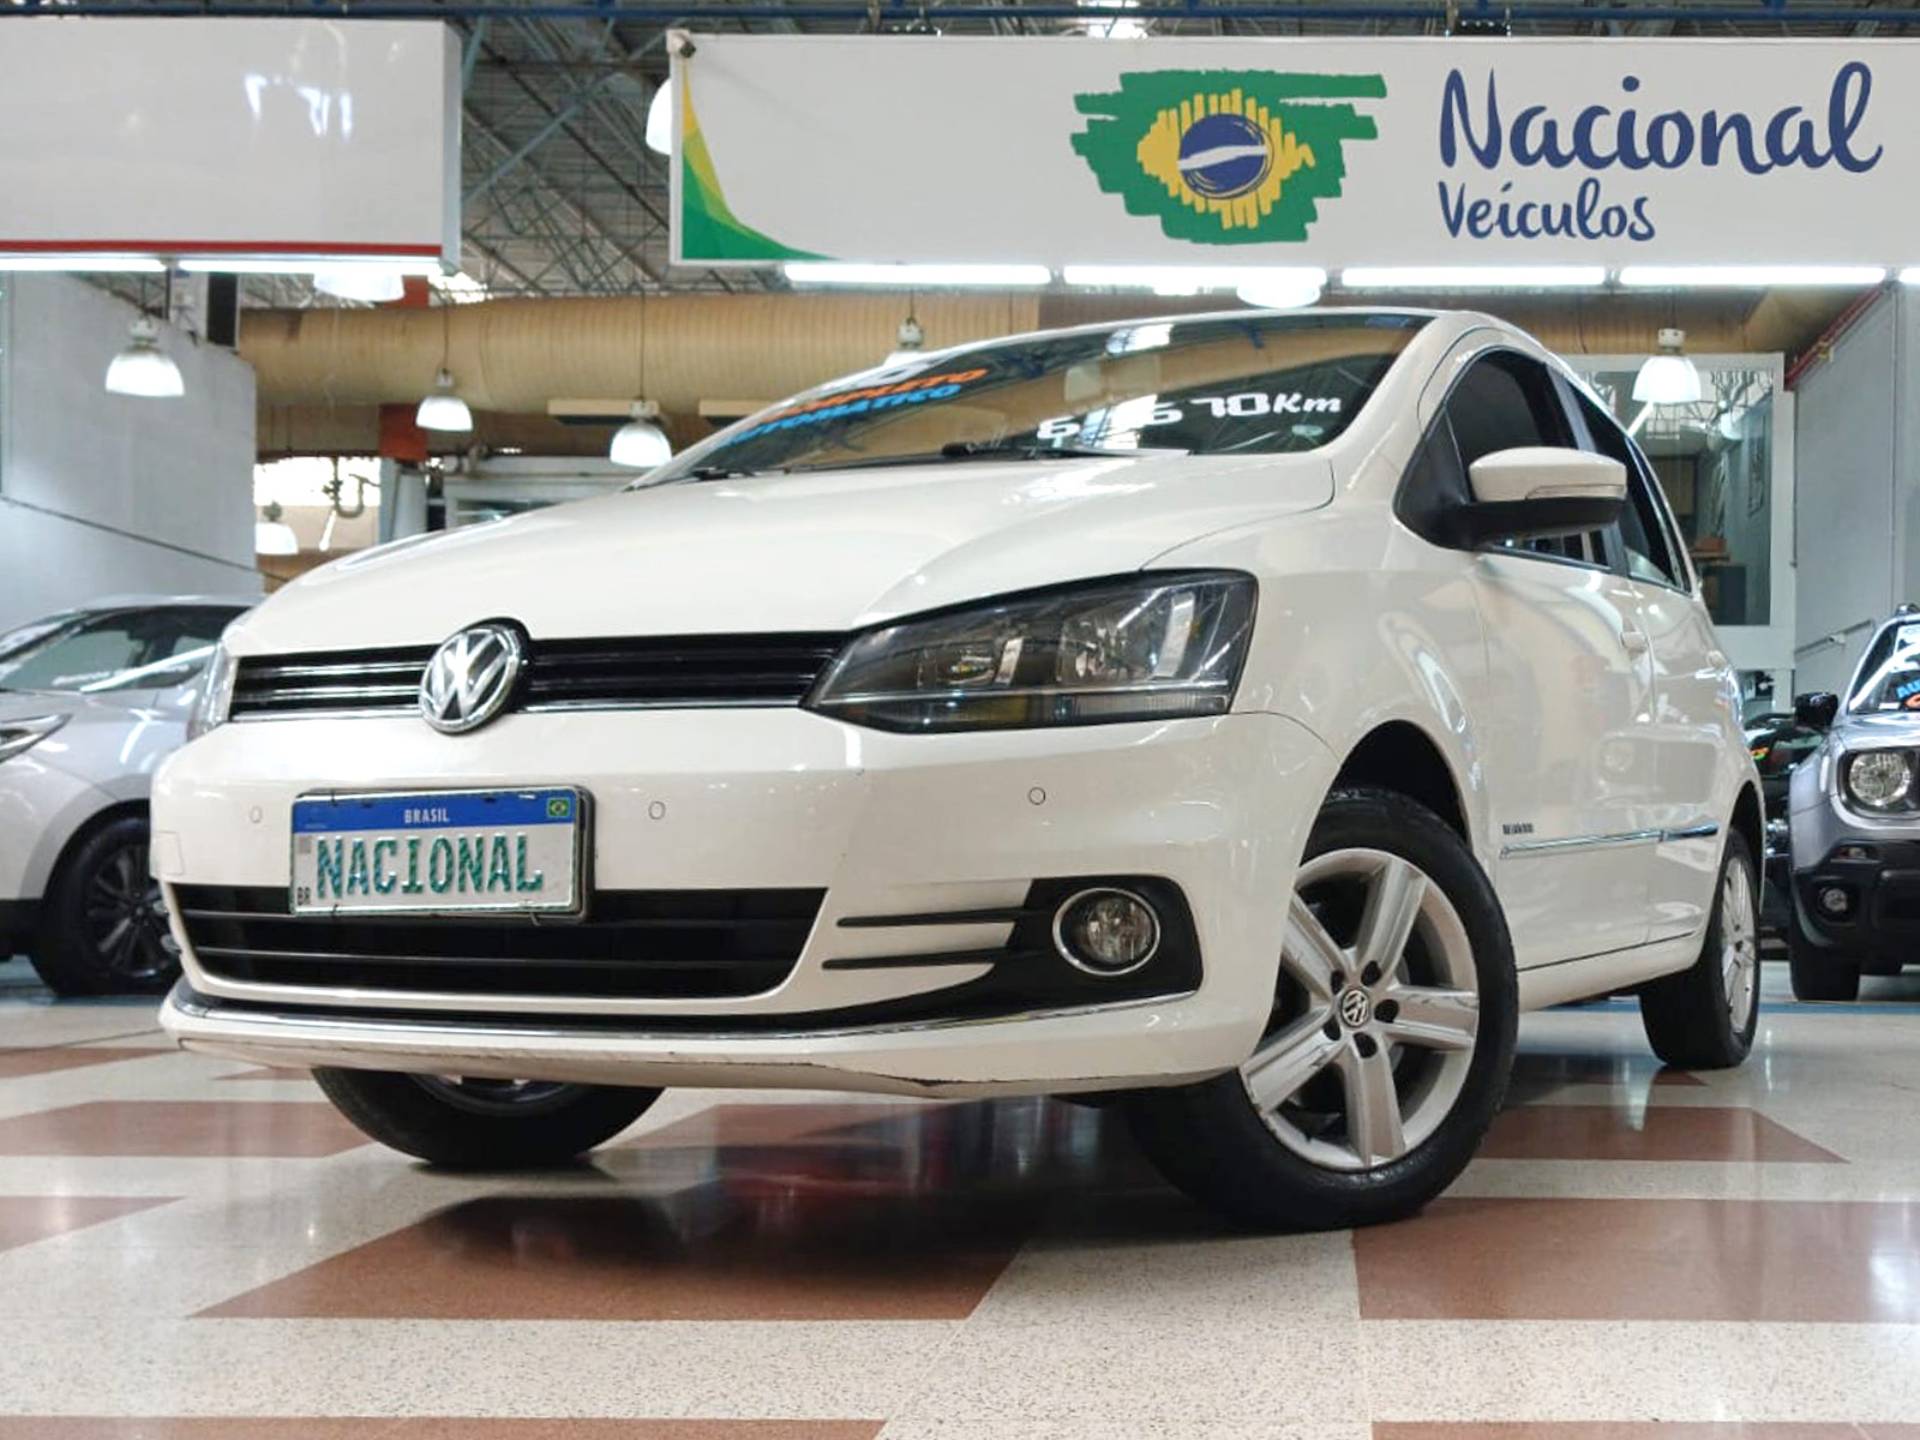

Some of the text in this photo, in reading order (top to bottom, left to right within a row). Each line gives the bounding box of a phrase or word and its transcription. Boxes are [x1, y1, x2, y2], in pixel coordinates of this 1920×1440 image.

[1440, 61, 1883, 174] Nacional
[1439, 177, 1655, 242] Veículos
[404, 808, 449, 824] BRASIL
[316, 832, 545, 898] NACIONAL
